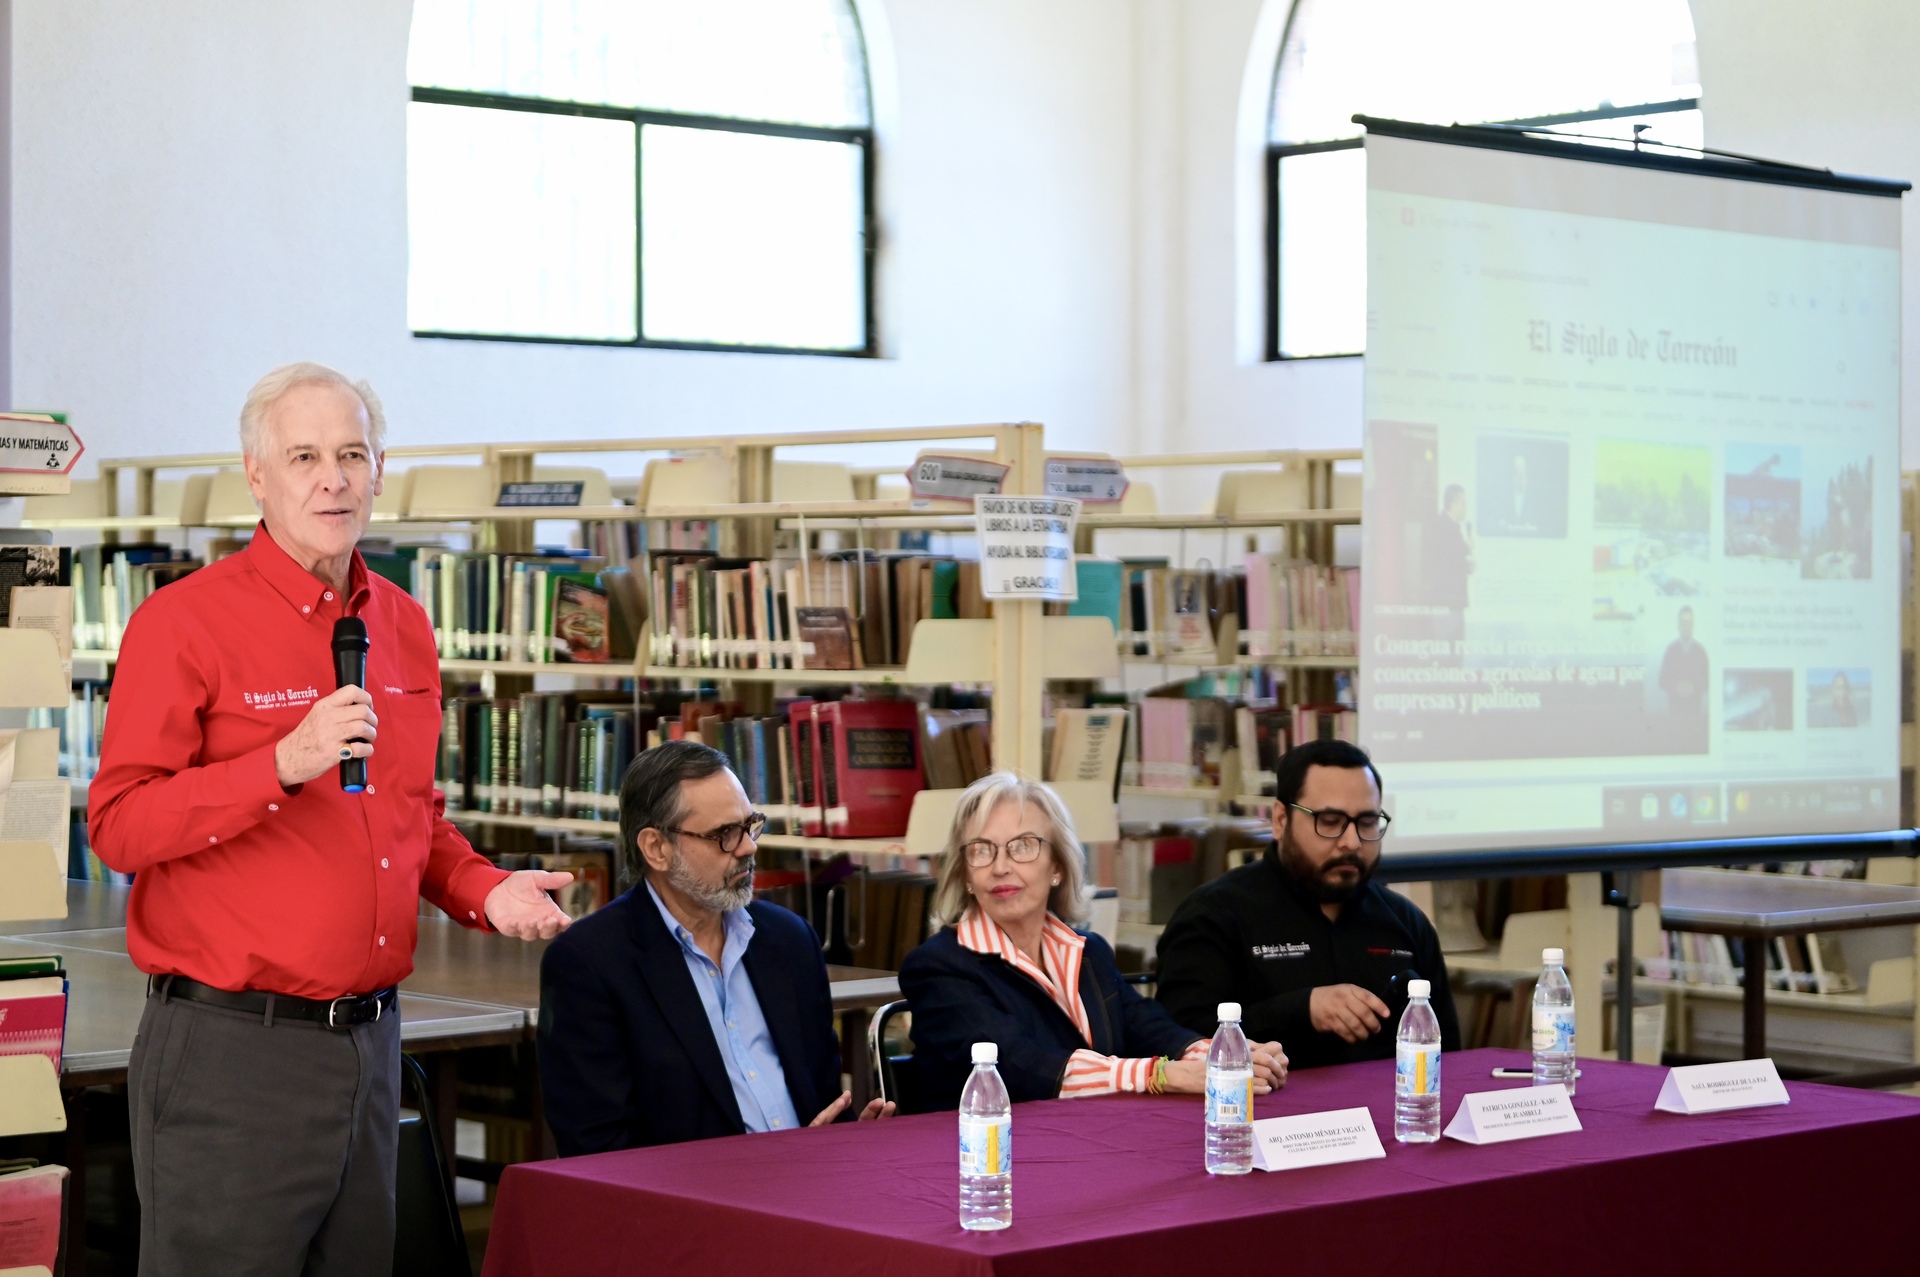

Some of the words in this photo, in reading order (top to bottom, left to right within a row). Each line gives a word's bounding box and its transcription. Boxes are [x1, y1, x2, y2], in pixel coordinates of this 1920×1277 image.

[1527, 318, 1551, 353] El
[1561, 321, 1618, 364] Siglo
[1627, 327, 1649, 360] de
[1656, 328, 1738, 366] Torreón
[13, 438, 17, 449] Y
[19, 436, 69, 451] MATEMÁTICAS
[921, 463, 939, 480] 600
[983, 500, 1006, 514] FAVOR
[1007, 500, 1017, 514] DE
[1018, 501, 1028, 514] NO
[1060, 503, 1074, 517] LOS
[985, 518, 1012, 531] LIBROS
[1014, 518, 1020, 531] A
[1021, 518, 1031, 531] LA
[986, 545, 1013, 558] AYUDA
[1014, 545, 1024, 558] AL
[1374, 634, 1450, 659] Conagua
[1373, 661, 1478, 682] concesiones
[1480, 660, 1553, 685] agrícolas
[1555, 660, 1576, 681] de
[1578, 666, 1616, 685] agua
[1619, 666, 1646, 686] por
[244, 692, 253, 703] El
[254, 691, 276, 705] Siglo
[276, 690, 286, 700] de
[286, 686, 318, 700] Torreón
[1373, 692, 1455, 715] empresas
[1457, 692, 1470, 714] y
[1472, 685, 1541, 715] políticos
[1739, 1078, 1748, 1086] DE
[1482, 1104, 1508, 1112] PATRICIA
[1508, 1099, 1538, 1110] GONZÁLEZ
[1541, 1097, 1558, 1105] KARG
[1285, 1132, 1314, 1142] ANTONIO
[1314, 1128, 1342, 1138] MÉNDEZ
[1342, 1123, 1366, 1134] VIGATÁ
